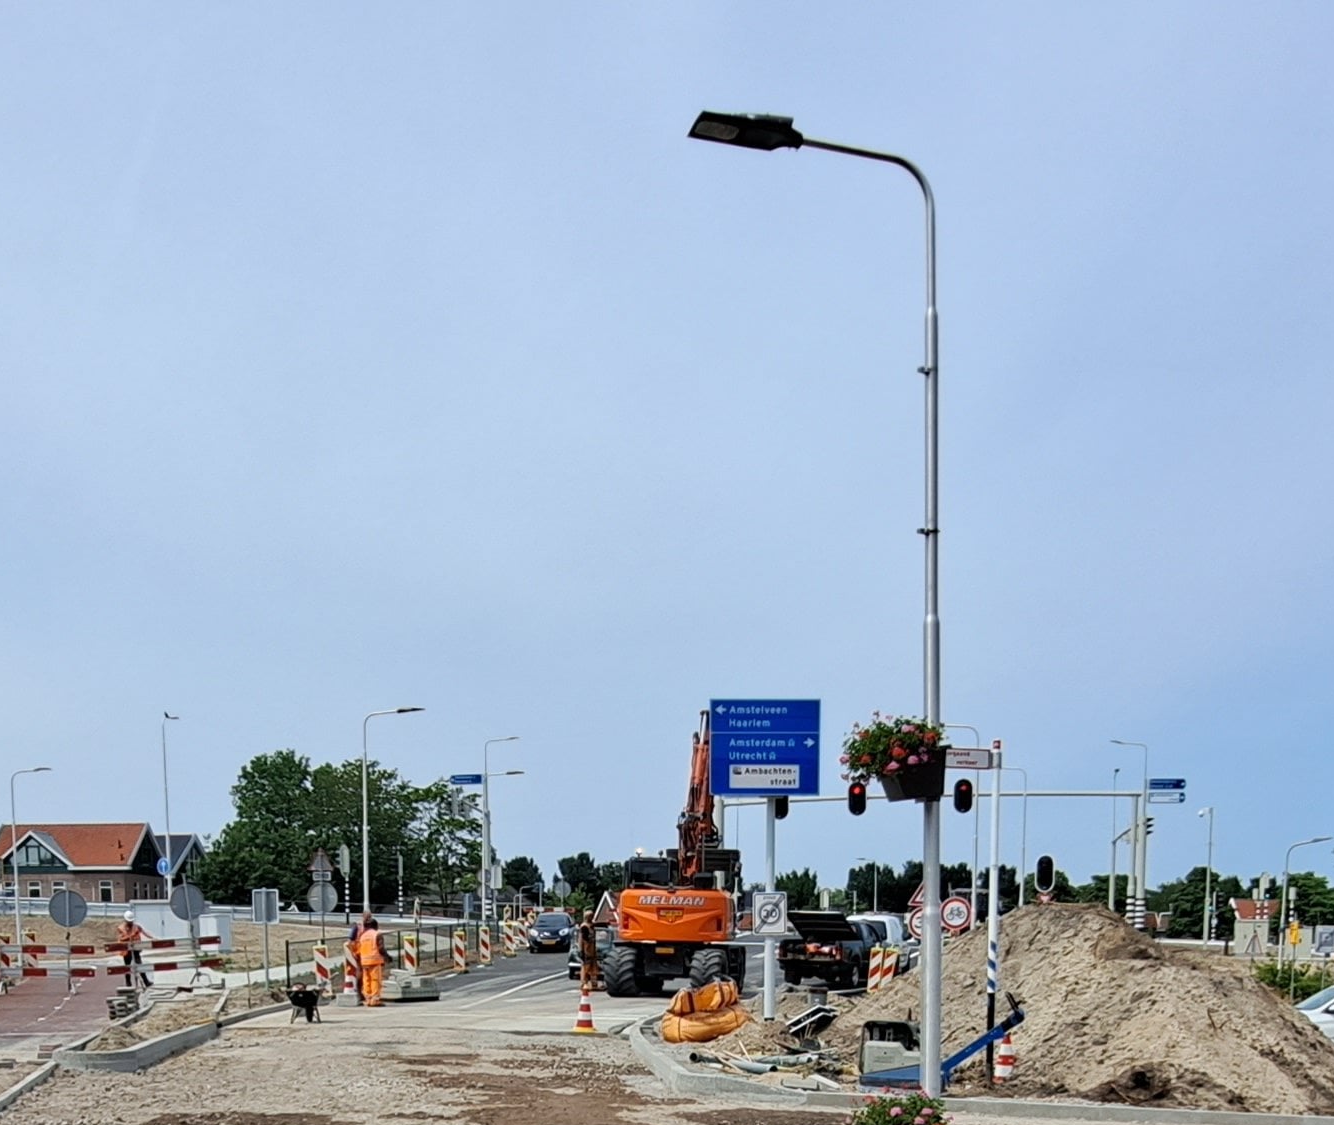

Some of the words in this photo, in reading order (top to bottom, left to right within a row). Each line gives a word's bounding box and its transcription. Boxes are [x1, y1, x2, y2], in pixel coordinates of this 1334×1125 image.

[729, 705, 788, 714] Amstelveen
[729, 718, 771, 727] Haarlem
[729, 738, 786, 747] Amsterdam
[729, 751, 767, 760] Utrecht
[744, 767, 796, 775] Ambachten-
[770, 778, 796, 786] straat
[638, 895, 705, 906] MELMAN
[763, 908, 777, 919] 30
